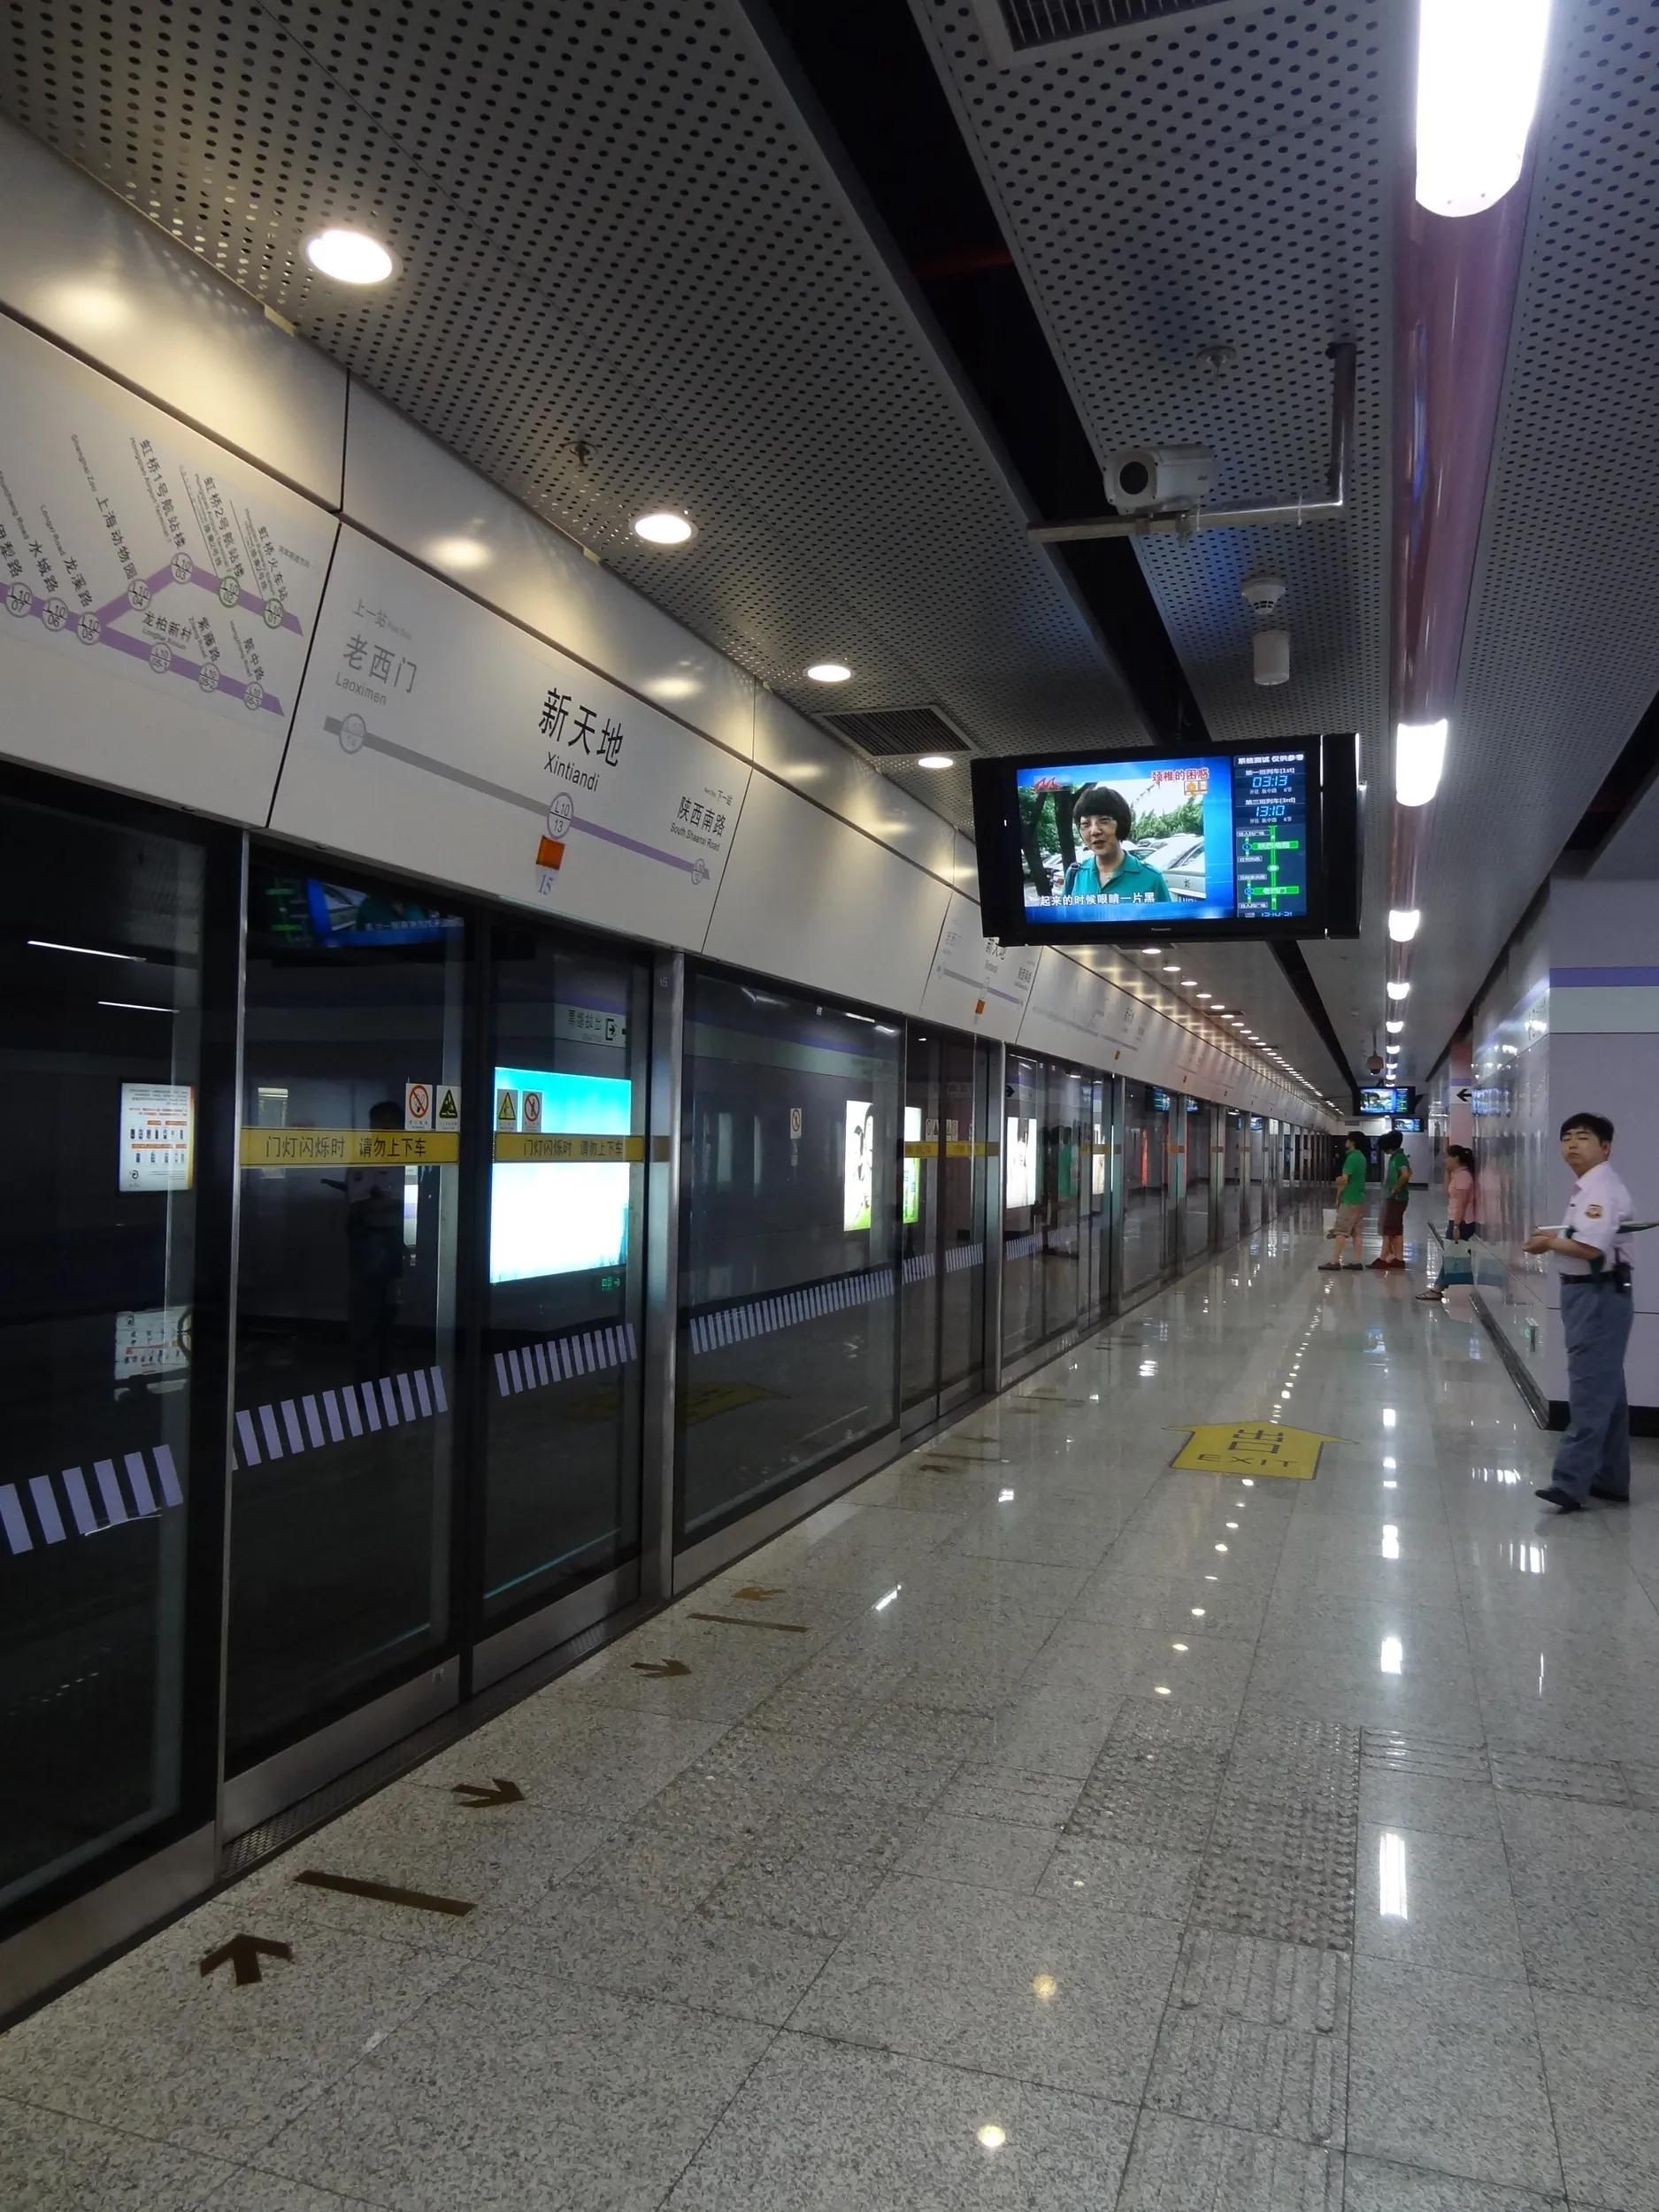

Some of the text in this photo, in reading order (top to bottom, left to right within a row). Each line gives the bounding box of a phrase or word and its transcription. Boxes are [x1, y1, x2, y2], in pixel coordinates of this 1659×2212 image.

[139, 439, 187, 549] 虹桥1号航站楼
[204, 476, 244, 578] 虹桥2号航站楼
[96, 497, 138, 580] 上海动物园
[29, 541, 58, 593] 水城路
[258, 526, 288, 602] 虹桥火车站
[64, 557, 92, 607] 龙溪路
[12, 585, 31, 603] L10
[12, 600, 25, 612] 07
[47, 599, 66, 616] L10
[352, 598, 388, 628] 上一站
[47, 614, 60, 627] 06
[81, 615, 100, 631] L10
[142, 611, 192, 641] 龙柏新村
[81, 628, 94, 641] 05
[155, 646, 169, 658] L10
[243, 637, 265, 681] 航中路
[343, 634, 418, 694] 老西门
[335, 672, 388, 706] Laoximen
[538, 687, 624, 767] 新天地
[544, 751, 600, 792] Xintiandi
[1152, 768, 1210, 782] 颈椎的困惑
[1252, 775, 1288, 787] 03:13
[554, 800, 571, 817] L10
[676, 796, 726, 838] 陕西南路
[1256, 805, 1286, 817] 13:10
[553, 818, 564, 833] 13
[670, 822, 721, 852] South Shaanxi Road
[538, 873, 554, 895] 15
[659, 977, 668, 987] 15
[265, 1136, 426, 1158] 门灯闪烁时 请勿上下车
[524, 1139, 623, 1157] 门灯闪烁时 请勿上下车
[1228, 1429, 1283, 1454] 出口
[1197, 1454, 1300, 1467] EXIT
